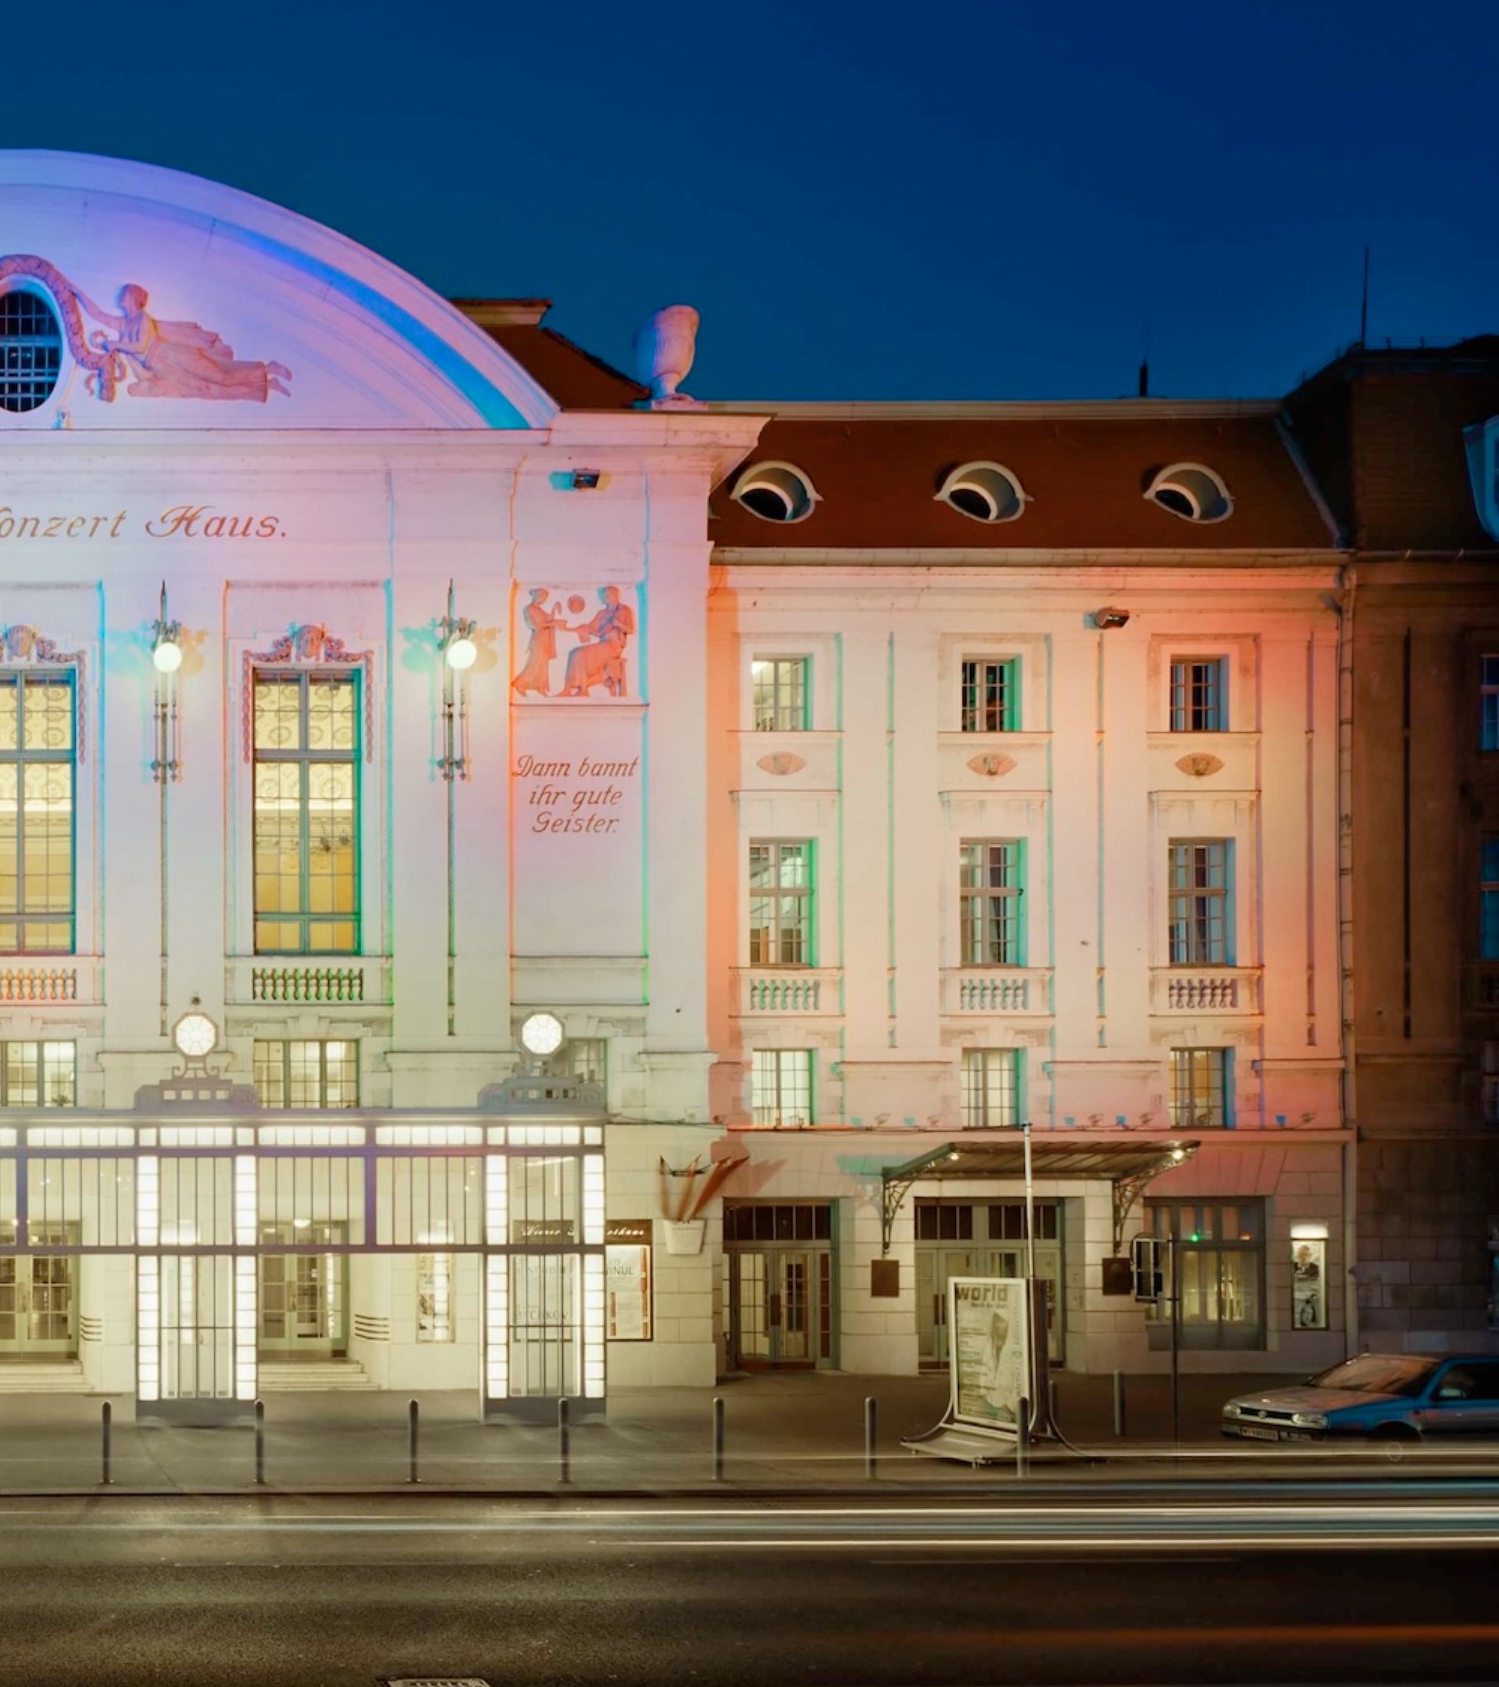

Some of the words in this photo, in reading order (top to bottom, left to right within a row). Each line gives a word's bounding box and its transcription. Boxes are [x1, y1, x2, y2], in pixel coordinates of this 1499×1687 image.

[144, 504, 289, 539] Haus.
[511, 754, 571, 778] Dann
[577, 756, 640, 778] bannt
[528, 783, 567, 806] ihr
[571, 783, 623, 813] gute
[956, 1283, 1008, 1302] world
